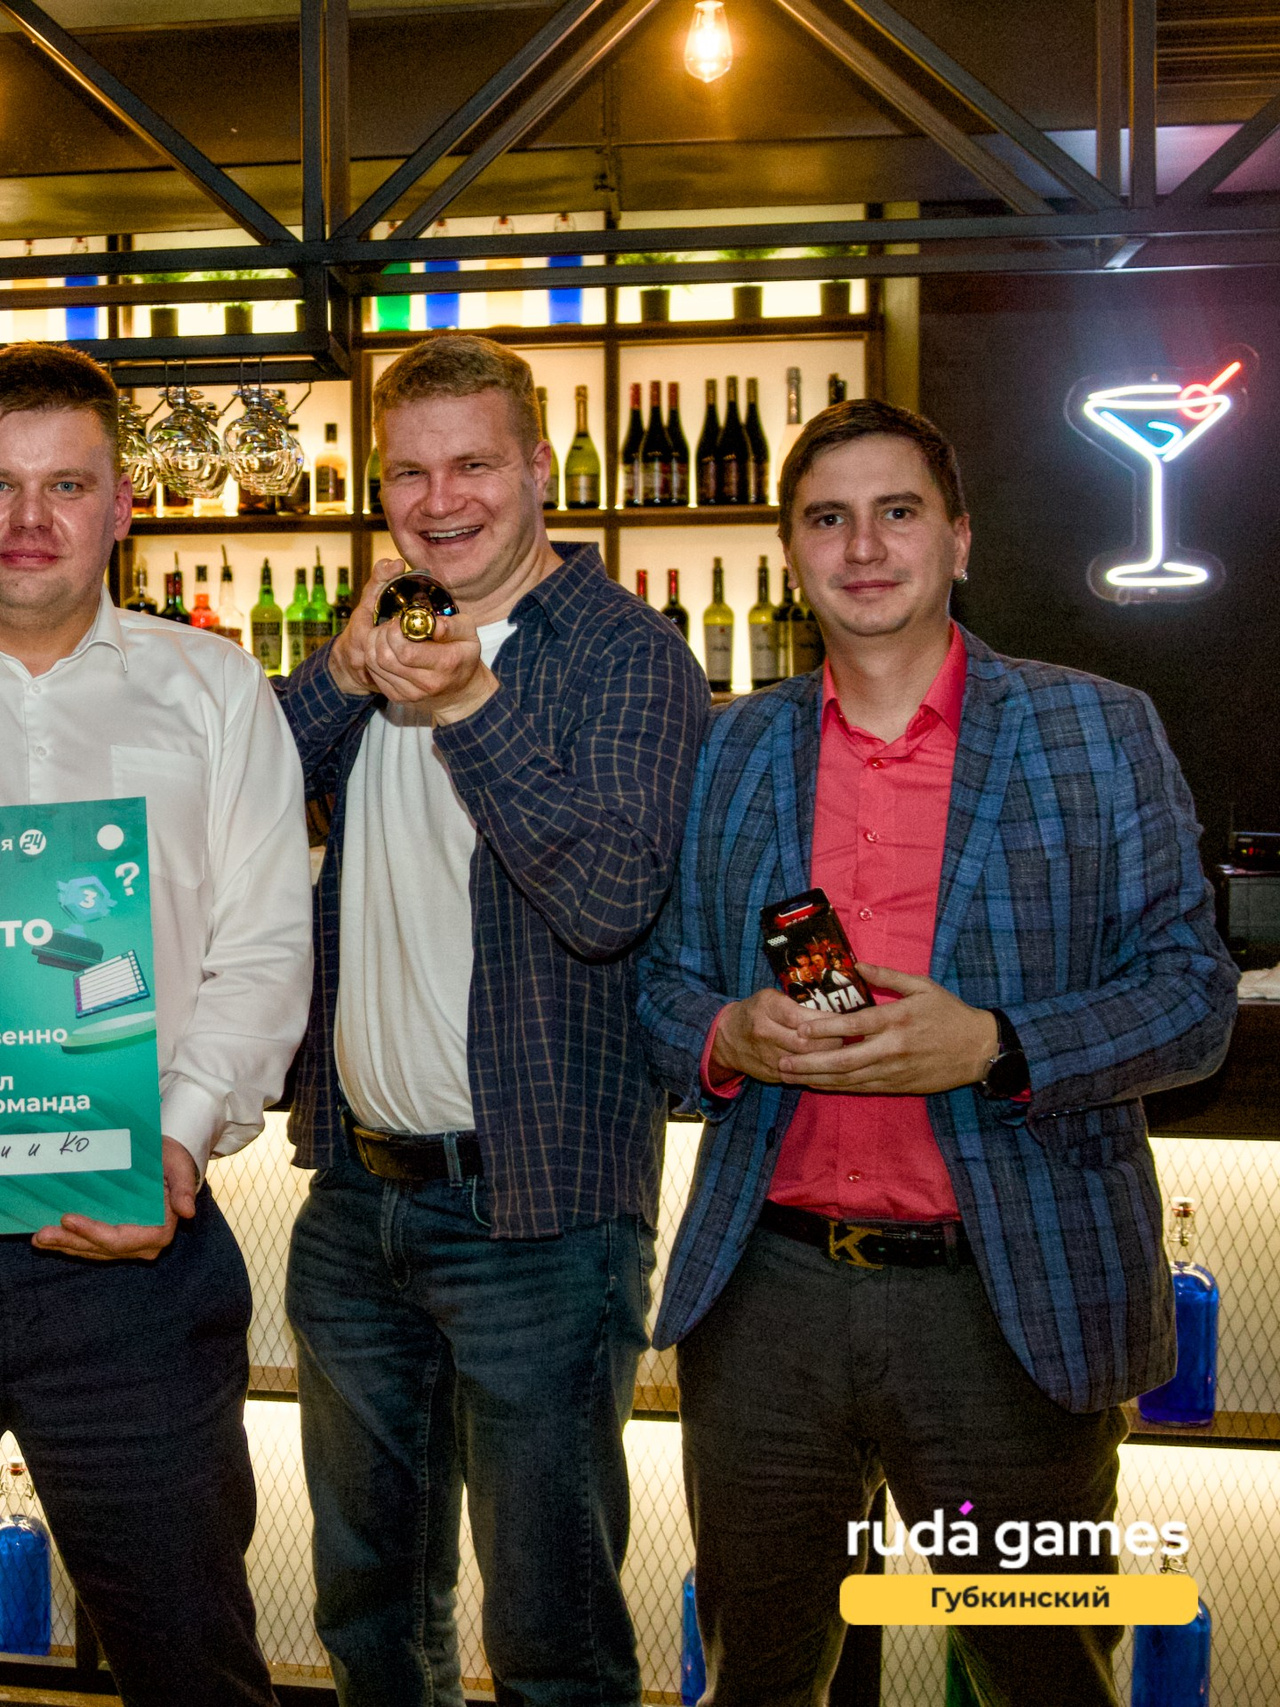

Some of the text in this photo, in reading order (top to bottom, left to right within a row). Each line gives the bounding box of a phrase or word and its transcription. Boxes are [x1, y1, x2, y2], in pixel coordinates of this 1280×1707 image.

[21, 832, 45, 853] 24
[114, 862, 140, 896] ?
[78, 889, 97, 909] 3
[28, 1142, 40, 1157] и
